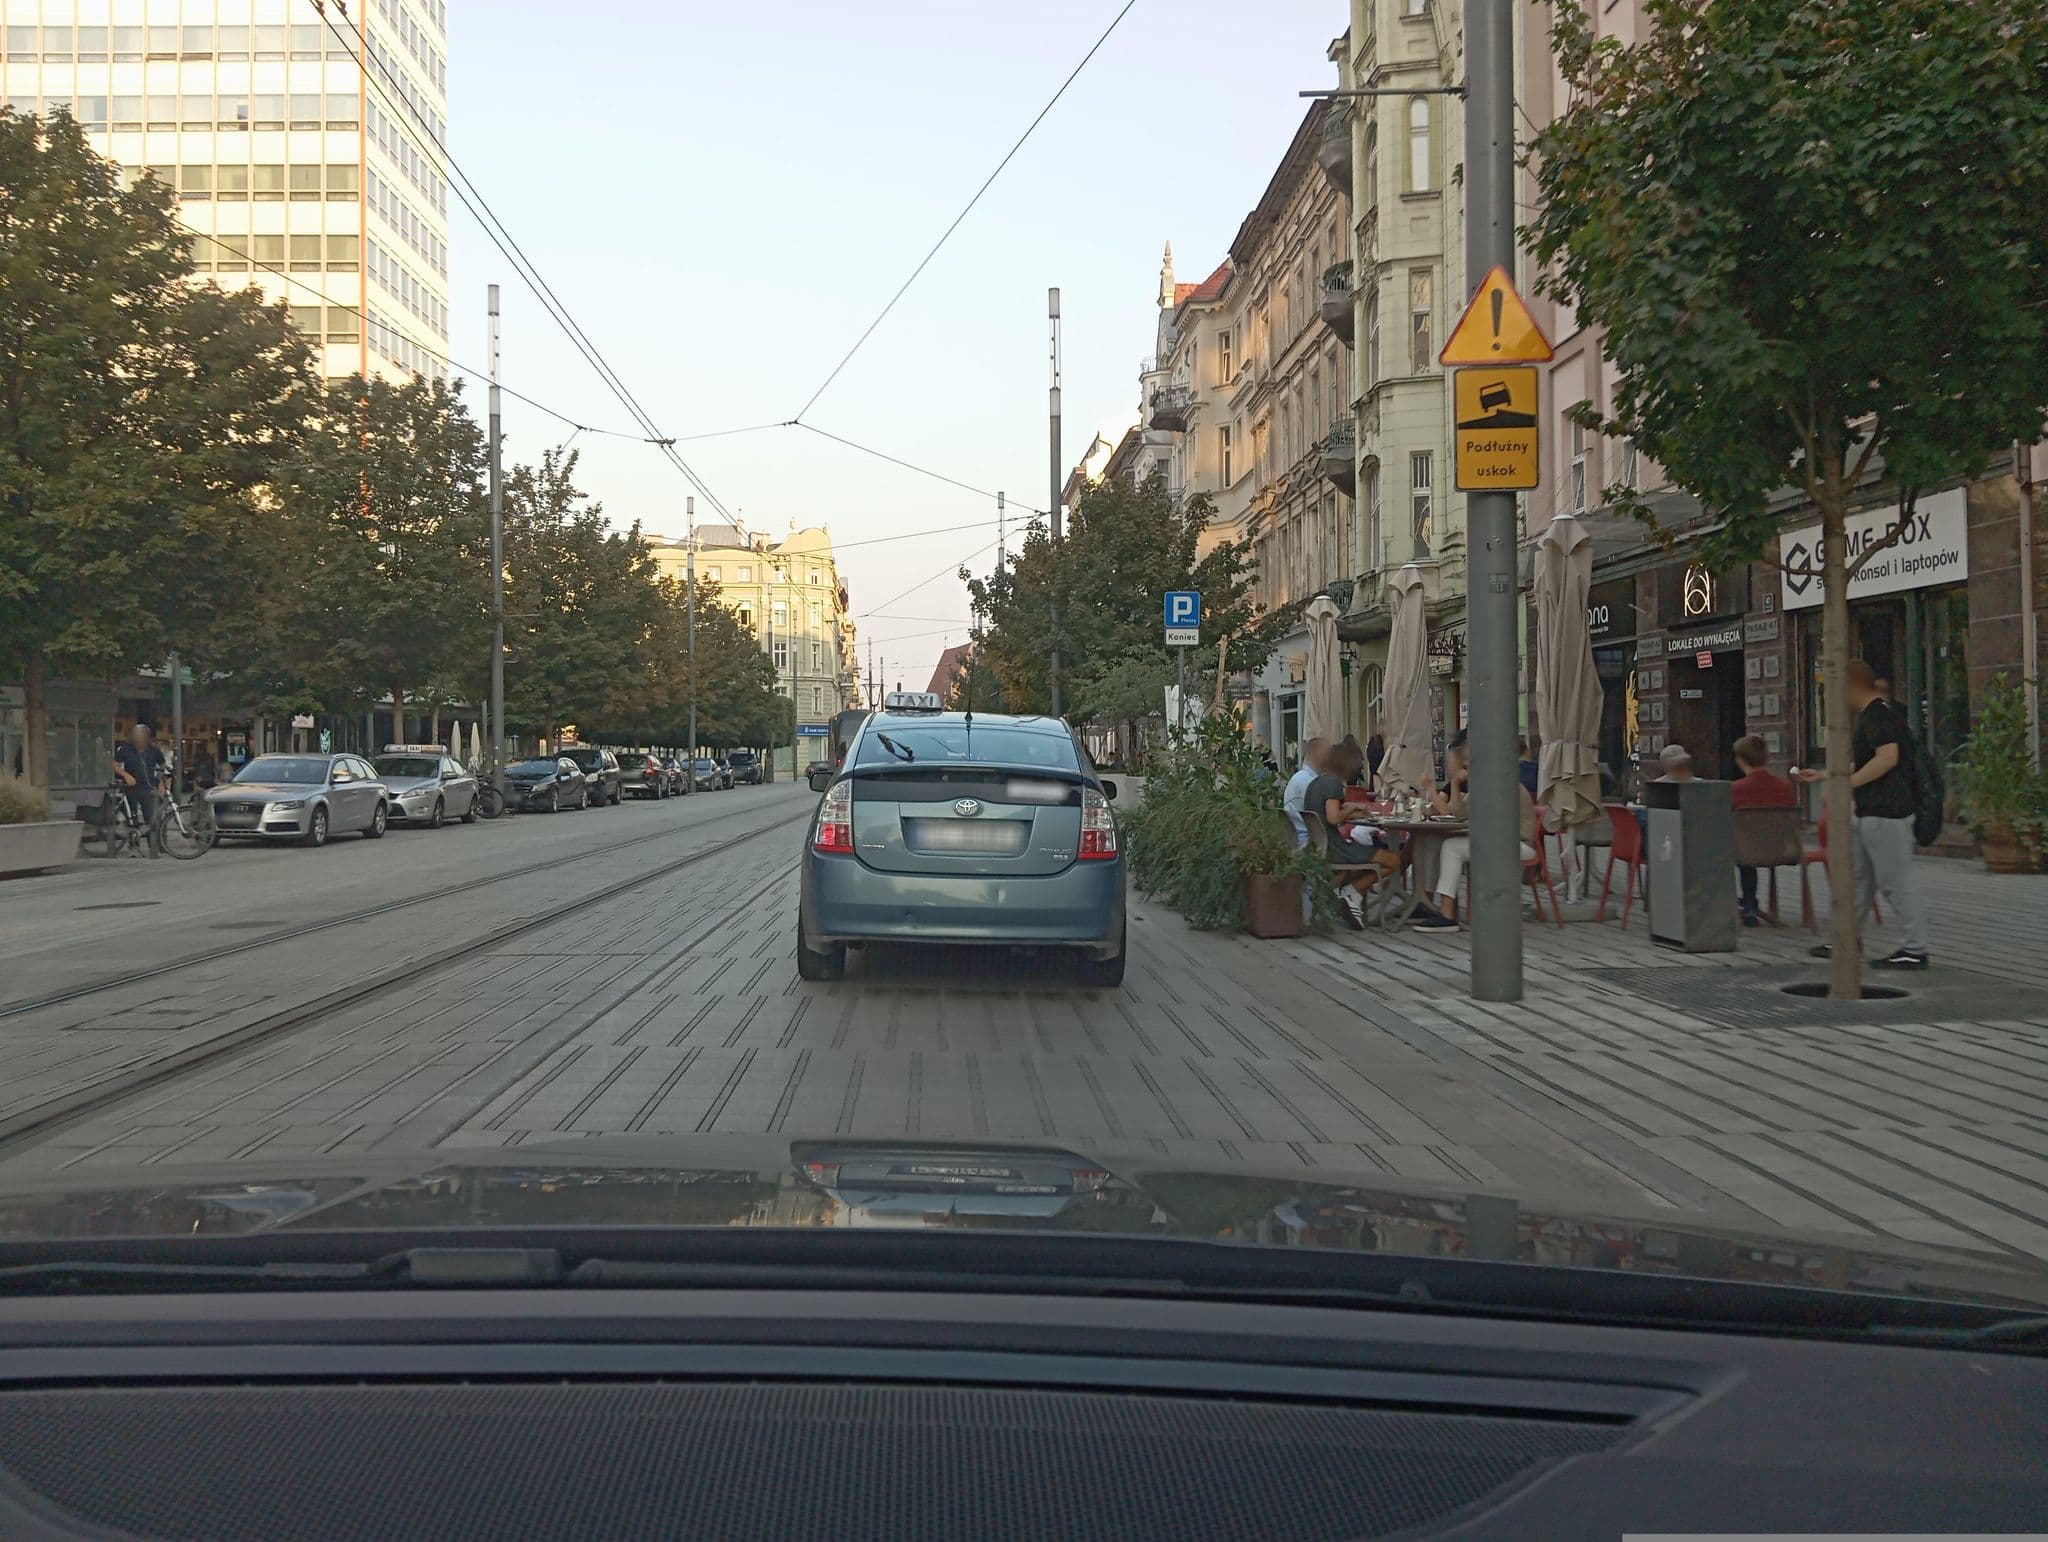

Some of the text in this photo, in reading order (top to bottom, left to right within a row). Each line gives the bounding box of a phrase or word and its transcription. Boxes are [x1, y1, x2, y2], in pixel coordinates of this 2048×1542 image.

[1466, 440, 1528, 454] Podłużny
[1477, 464, 1517, 476] uskok
[1815, 513, 1933, 563] GME BOX
[1894, 559, 1898, 576] i
[1902, 549, 1959, 576] laptopów
[1173, 596, 1192, 622] P
[1168, 632, 1197, 641] Koniec
[1668, 637, 1693, 652] LOKALE
[1693, 636, 1703, 648] DO
[1703, 629, 1741, 647] WYNAJĘCIA
[894, 694, 934, 707] TAXI
